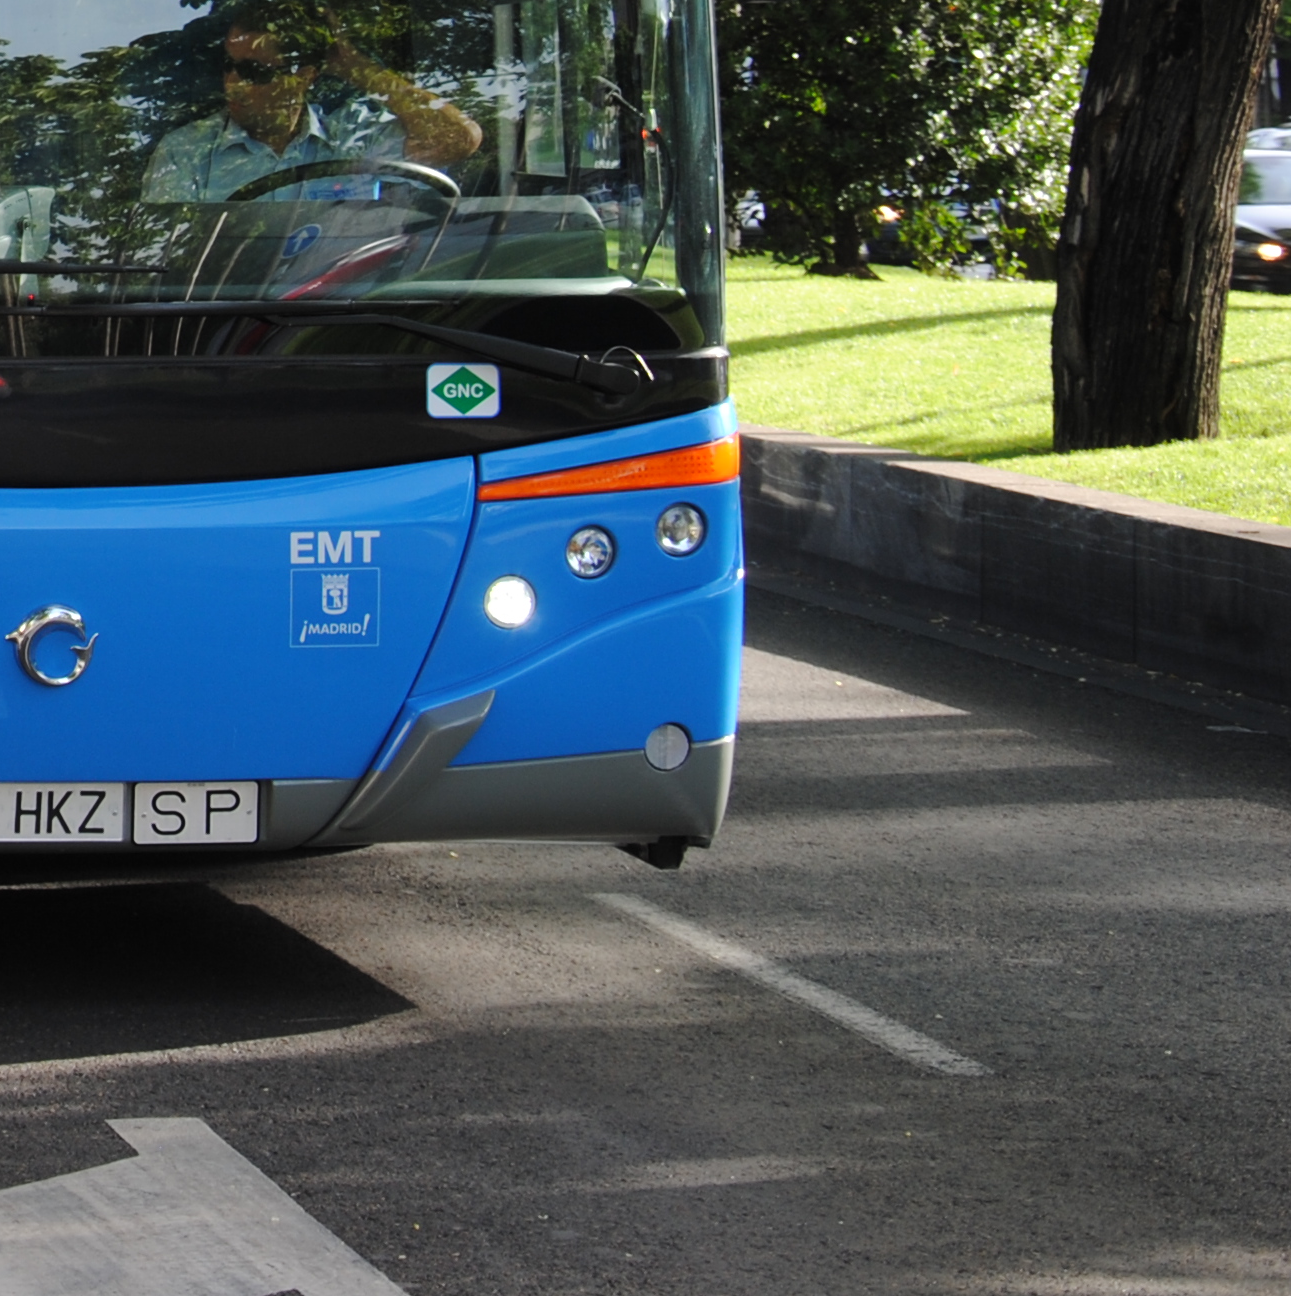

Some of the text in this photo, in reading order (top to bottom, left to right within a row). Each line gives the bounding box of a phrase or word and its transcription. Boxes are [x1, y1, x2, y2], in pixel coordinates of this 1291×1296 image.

[443, 383, 484, 399] GNC
[290, 530, 380, 565] EMT
[299, 613, 371, 643] ¡MADRID!
[14, 790, 107, 835] HKZ
